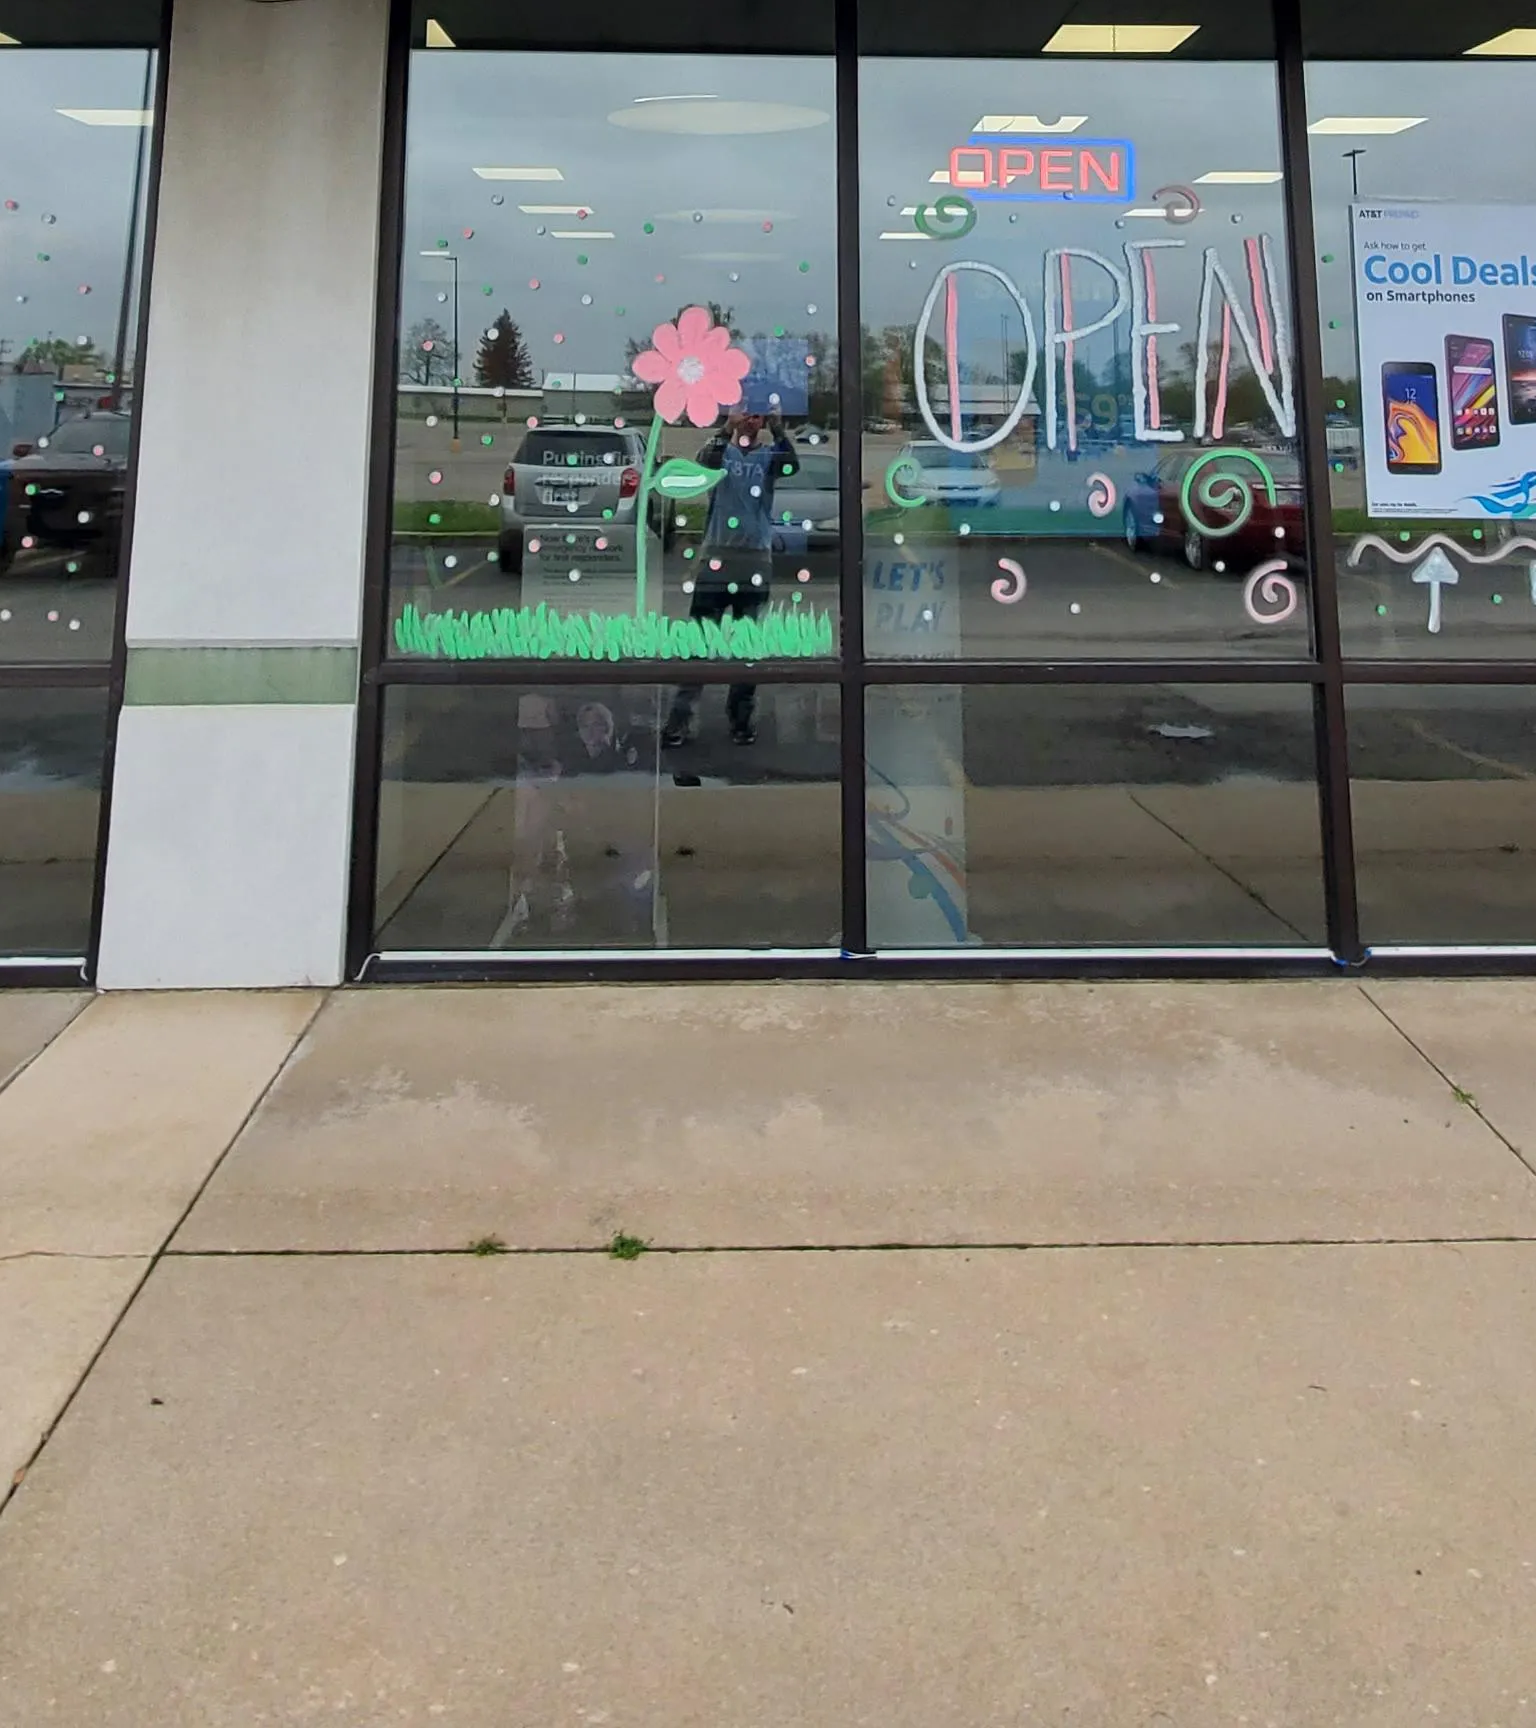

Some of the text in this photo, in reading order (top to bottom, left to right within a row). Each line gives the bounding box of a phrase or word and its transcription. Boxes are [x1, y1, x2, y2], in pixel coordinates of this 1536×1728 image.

[948, 146, 1121, 193] OPEN
[1359, 210, 1382, 219] AT&T
[1364, 242, 1426, 253] Ask how to get
[1364, 254, 1442, 285] Cool
[1367, 290, 1476, 305] on Smartphones
[914, 232, 1296, 454] OPEN
[872, 559, 946, 592] LET'S
